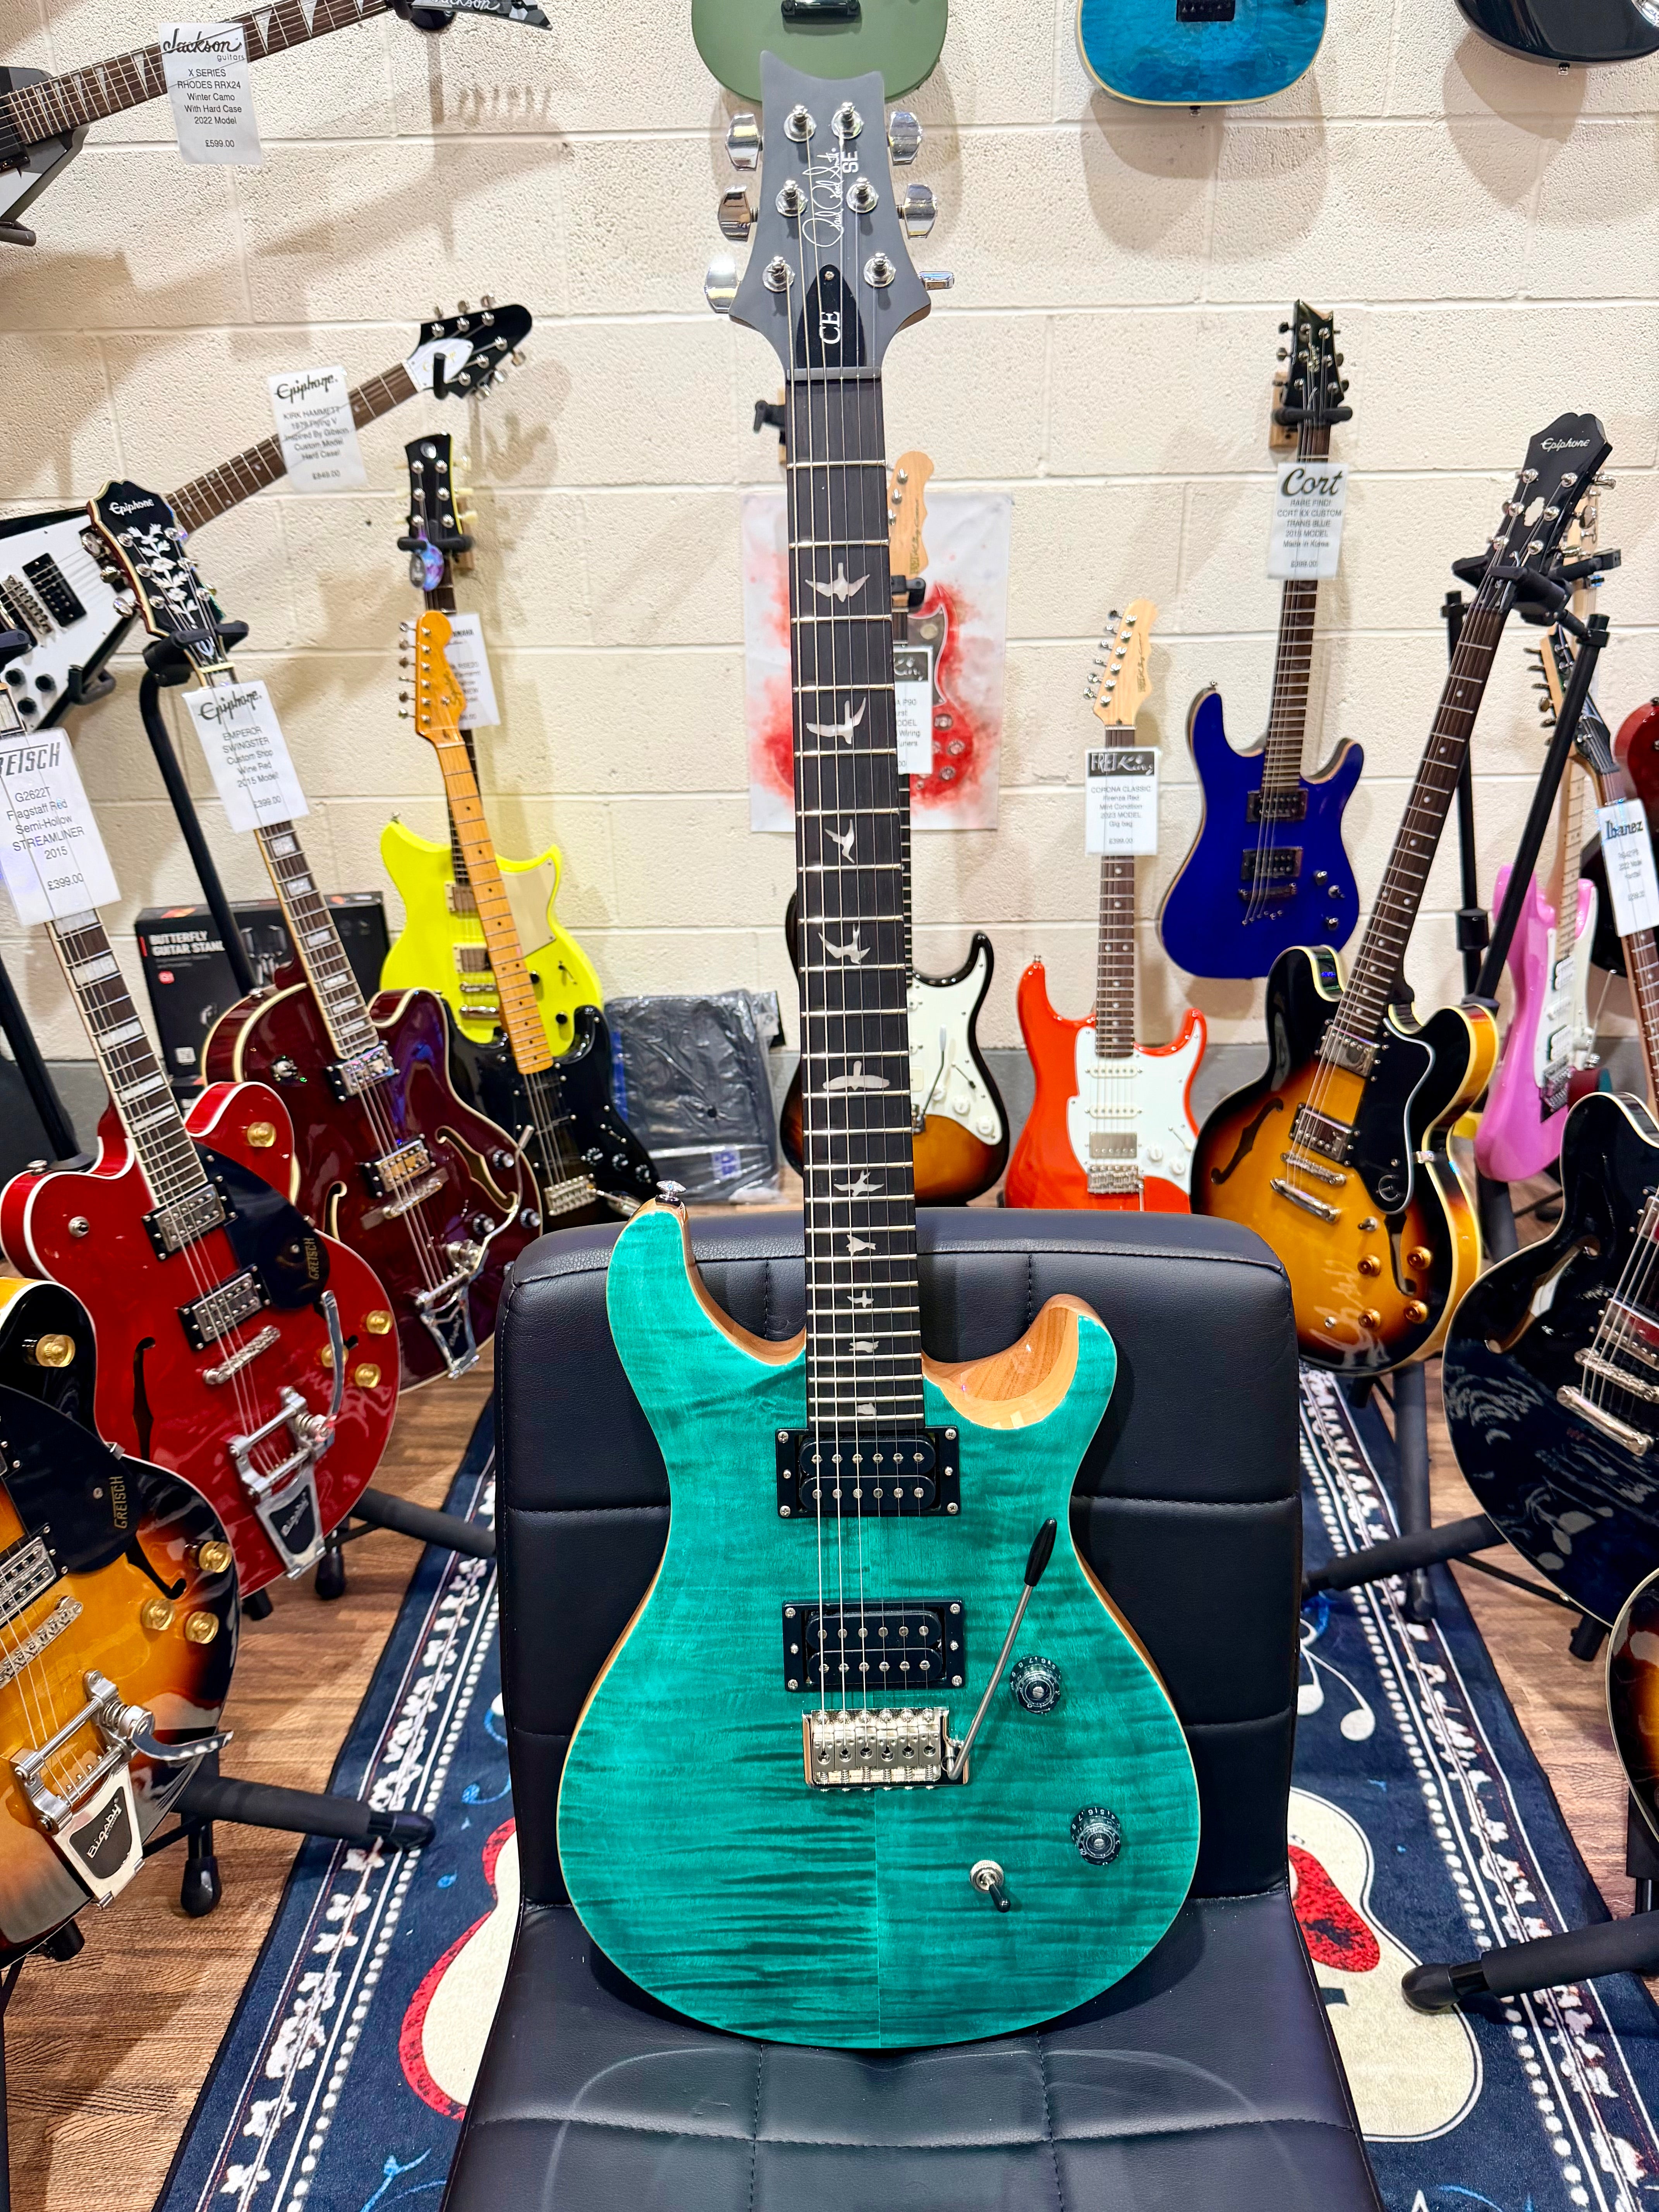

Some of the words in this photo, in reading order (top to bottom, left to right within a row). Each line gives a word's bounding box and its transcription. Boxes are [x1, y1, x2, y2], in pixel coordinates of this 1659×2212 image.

[163, 28, 242, 53] Jackson
[842, 151, 858, 173] SE
[819, 311, 840, 344] CE
[275, 374, 334, 404] Epiphone
[1541, 438, 1590, 452] Epiphone
[1281, 468, 1343, 497] Cort
[109, 499, 155, 515] Epiphone
[1277, 509, 1298, 517] CORT
[1311, 509, 1342, 517] CUSTOM
[198, 690, 259, 725] Epiphone
[223, 726, 262, 741] EMPEROR
[222, 737, 270, 753] SWINGSTER
[0, 742, 60, 776] ETSCH
[227, 753, 256, 765] Custom
[257, 749, 273, 759] Shop
[237, 765, 257, 775] Wine
[259, 761, 272, 770] Red
[237, 776, 257, 788] 2015
[15, 787, 51, 802] G2622T
[7, 804, 48, 821] Flagstaff
[50, 799, 68, 811] Red
[16, 815, 72, 835] Semi-Hollow
[1605, 820, 1644, 840] Ibanez
[12, 826, 85, 851] STREAMLINER
[44, 846, 68, 859] 2015
[47, 873, 84, 891] £399.00
[149, 931, 208, 945] BUTTERFLY
[152, 943, 191, 957] GUITAR
[303, 1238, 319, 1280] GRETSCH
[108, 1476, 128, 1529] GRETSCH
[86, 1803, 122, 1858] Bigsby
